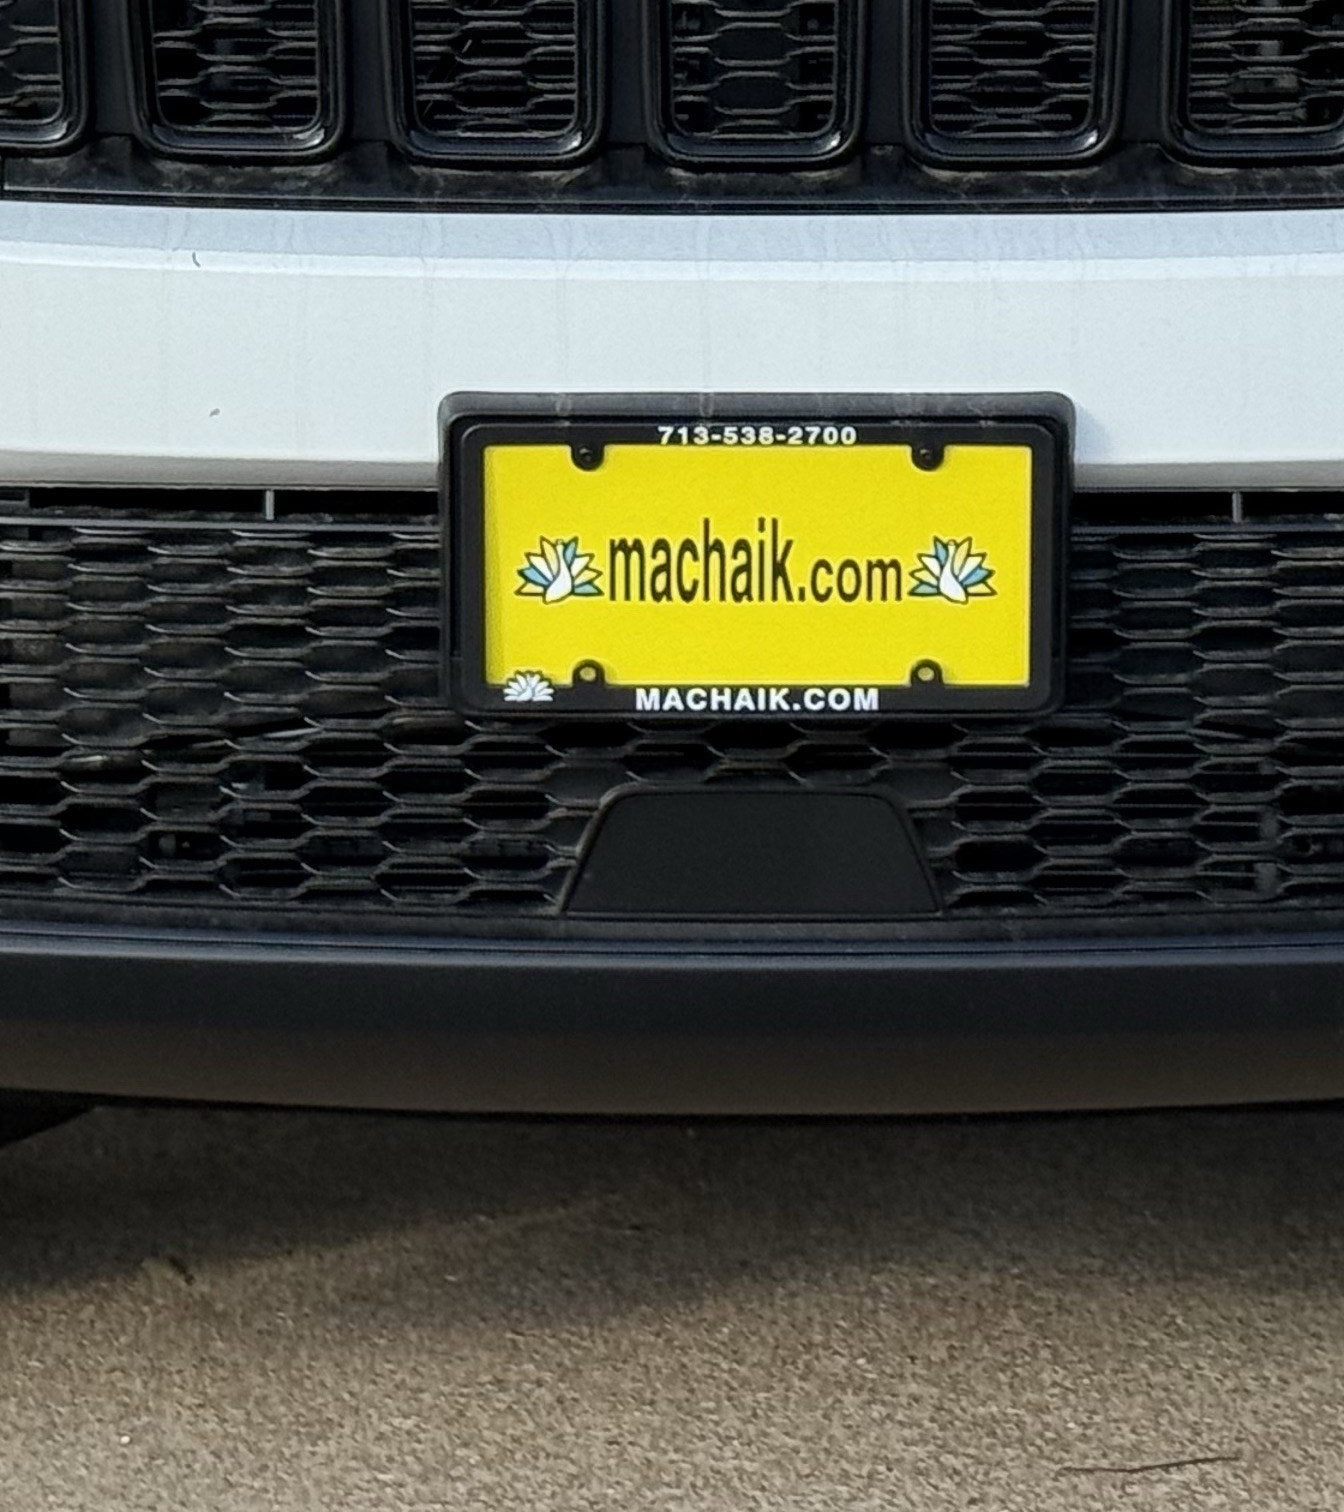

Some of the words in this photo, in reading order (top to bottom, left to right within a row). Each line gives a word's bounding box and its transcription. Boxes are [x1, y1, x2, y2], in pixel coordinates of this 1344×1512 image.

[657, 425, 857, 445] 713-538-2700
[609, 516, 903, 603] machaik.com
[635, 687, 879, 711] MACHAIK.COM
